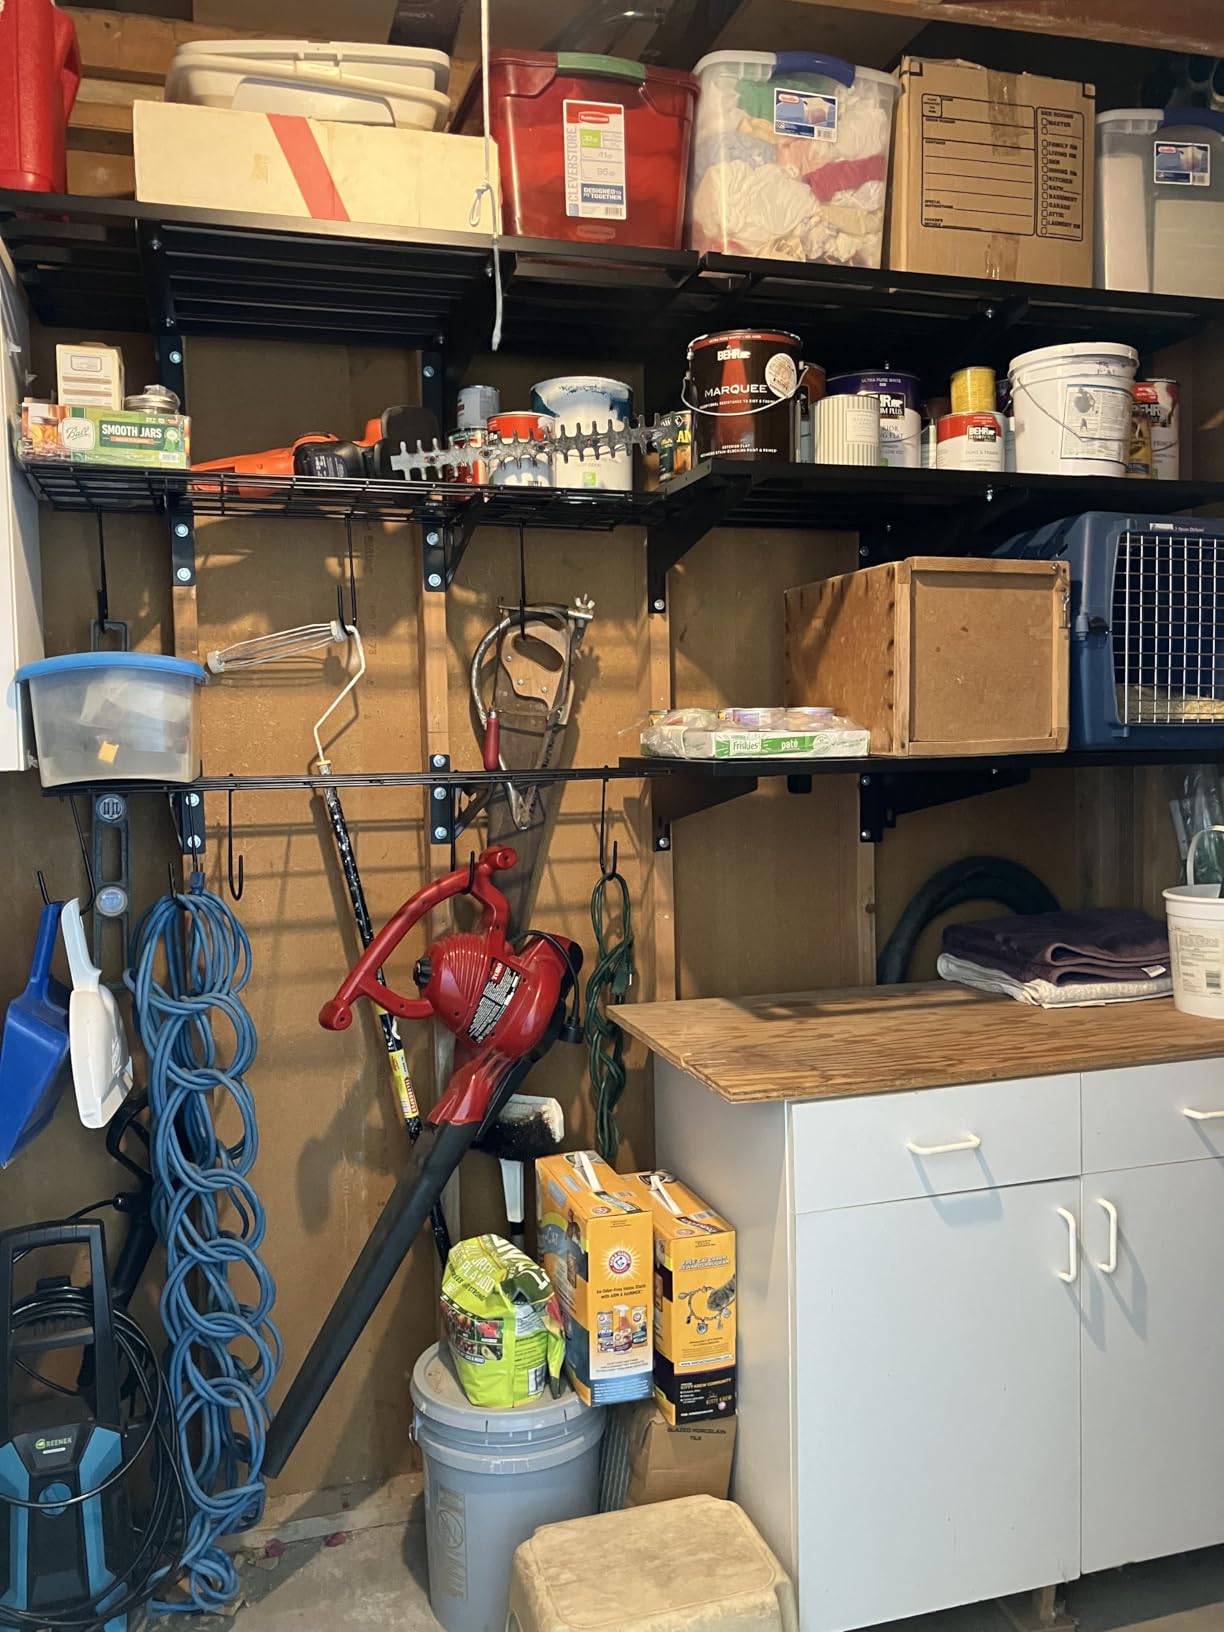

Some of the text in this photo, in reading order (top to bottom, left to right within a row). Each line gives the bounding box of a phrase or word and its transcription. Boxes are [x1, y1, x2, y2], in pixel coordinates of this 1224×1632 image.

[1048, 120, 1071, 128] MASTER
[1048, 141, 1068, 149] FAMILY
[566, 126, 579, 202] CLEVERSTORE
[591, 192, 622, 200] TOGETHER
[1048, 193, 1078, 202] BASEMENT
[1048, 202, 1071, 210] GARAGE
[717, 348, 741, 361] BEHR
[704, 384, 768, 398] MARQUEE
[889, 407, 903, 415] PLUS
[66, 427, 91, 440] Ball
[101, 424, 162, 438] SMOOTH JARS
[969, 427, 989, 435] BEHR
[732, 739, 758, 750] friskies
[491, 962, 503, 981] TORO
